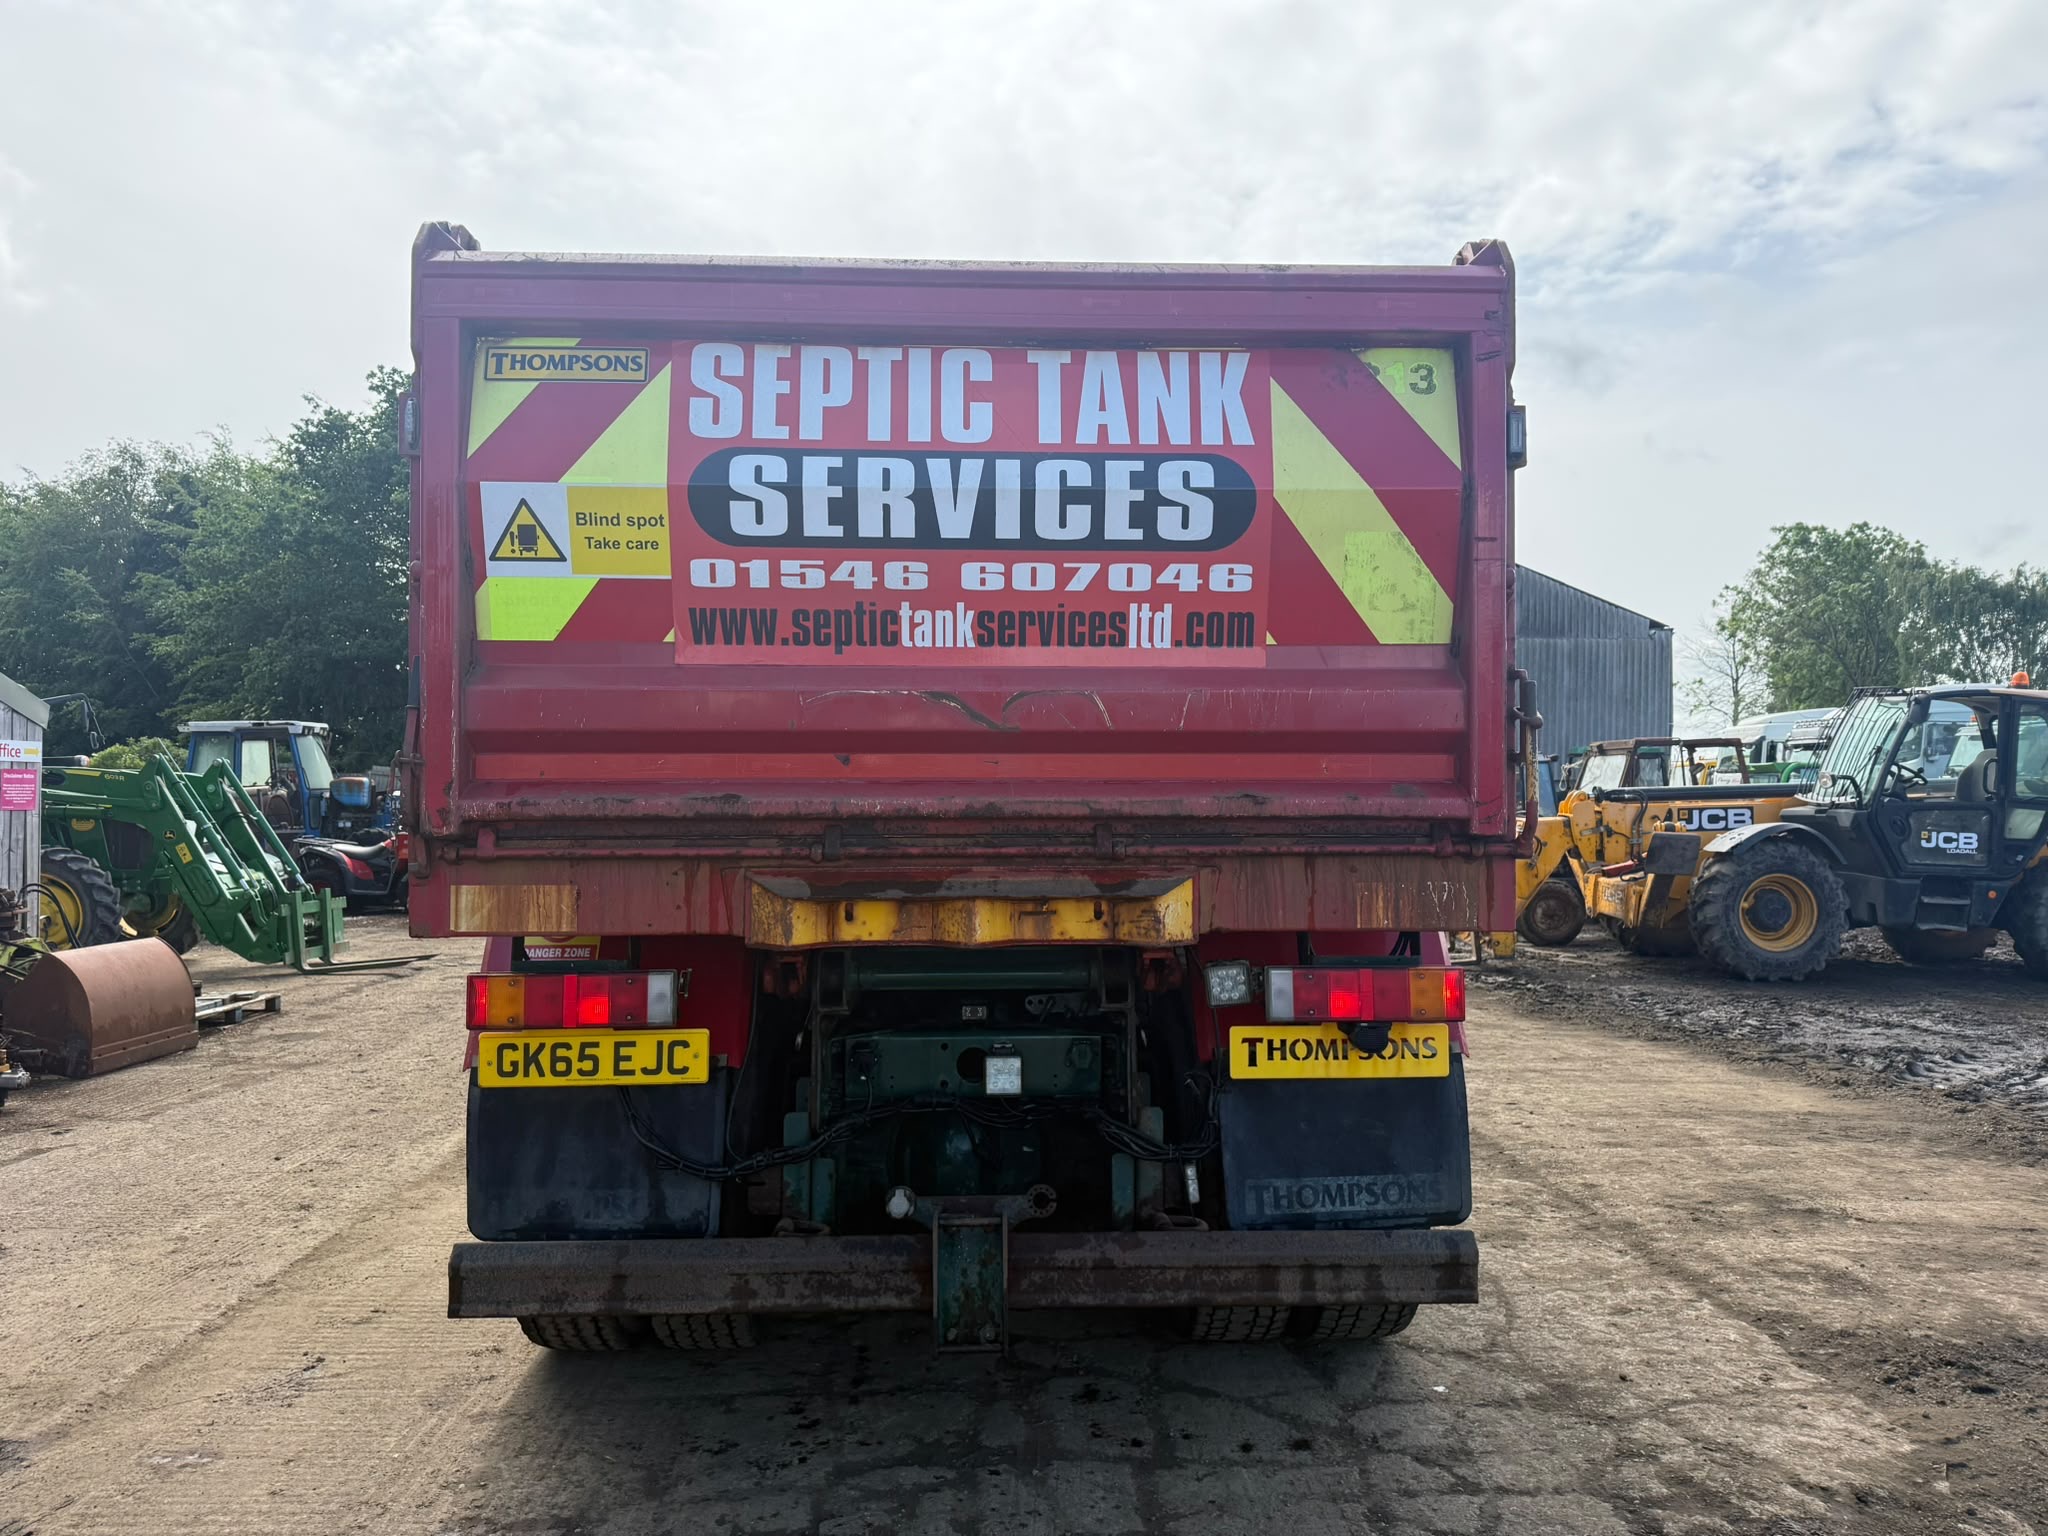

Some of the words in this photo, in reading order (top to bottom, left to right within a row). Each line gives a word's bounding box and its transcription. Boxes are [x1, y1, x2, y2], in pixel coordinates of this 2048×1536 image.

[491, 352, 643, 375] THOMPSONS
[688, 343, 993, 443] SEPTIC
[1027, 350, 1256, 446] TANK
[728, 453, 1215, 543] SERVICES
[575, 511, 621, 527] Blind
[626, 513, 665, 531] spot
[584, 536, 620, 550] Take
[625, 539, 660, 550] care
[690, 558, 929, 590] 01546
[961, 562, 1253, 592] 607046
[688, 601, 1255, 655] www.septictankservicesltd.com
[1680, 808, 1753, 830] JCB
[1920, 831, 1978, 849] JCB
[564, 947, 591, 958] ZONE
[496, 1042, 600, 1078] GK65
[613, 1040, 691, 1077] EJC
